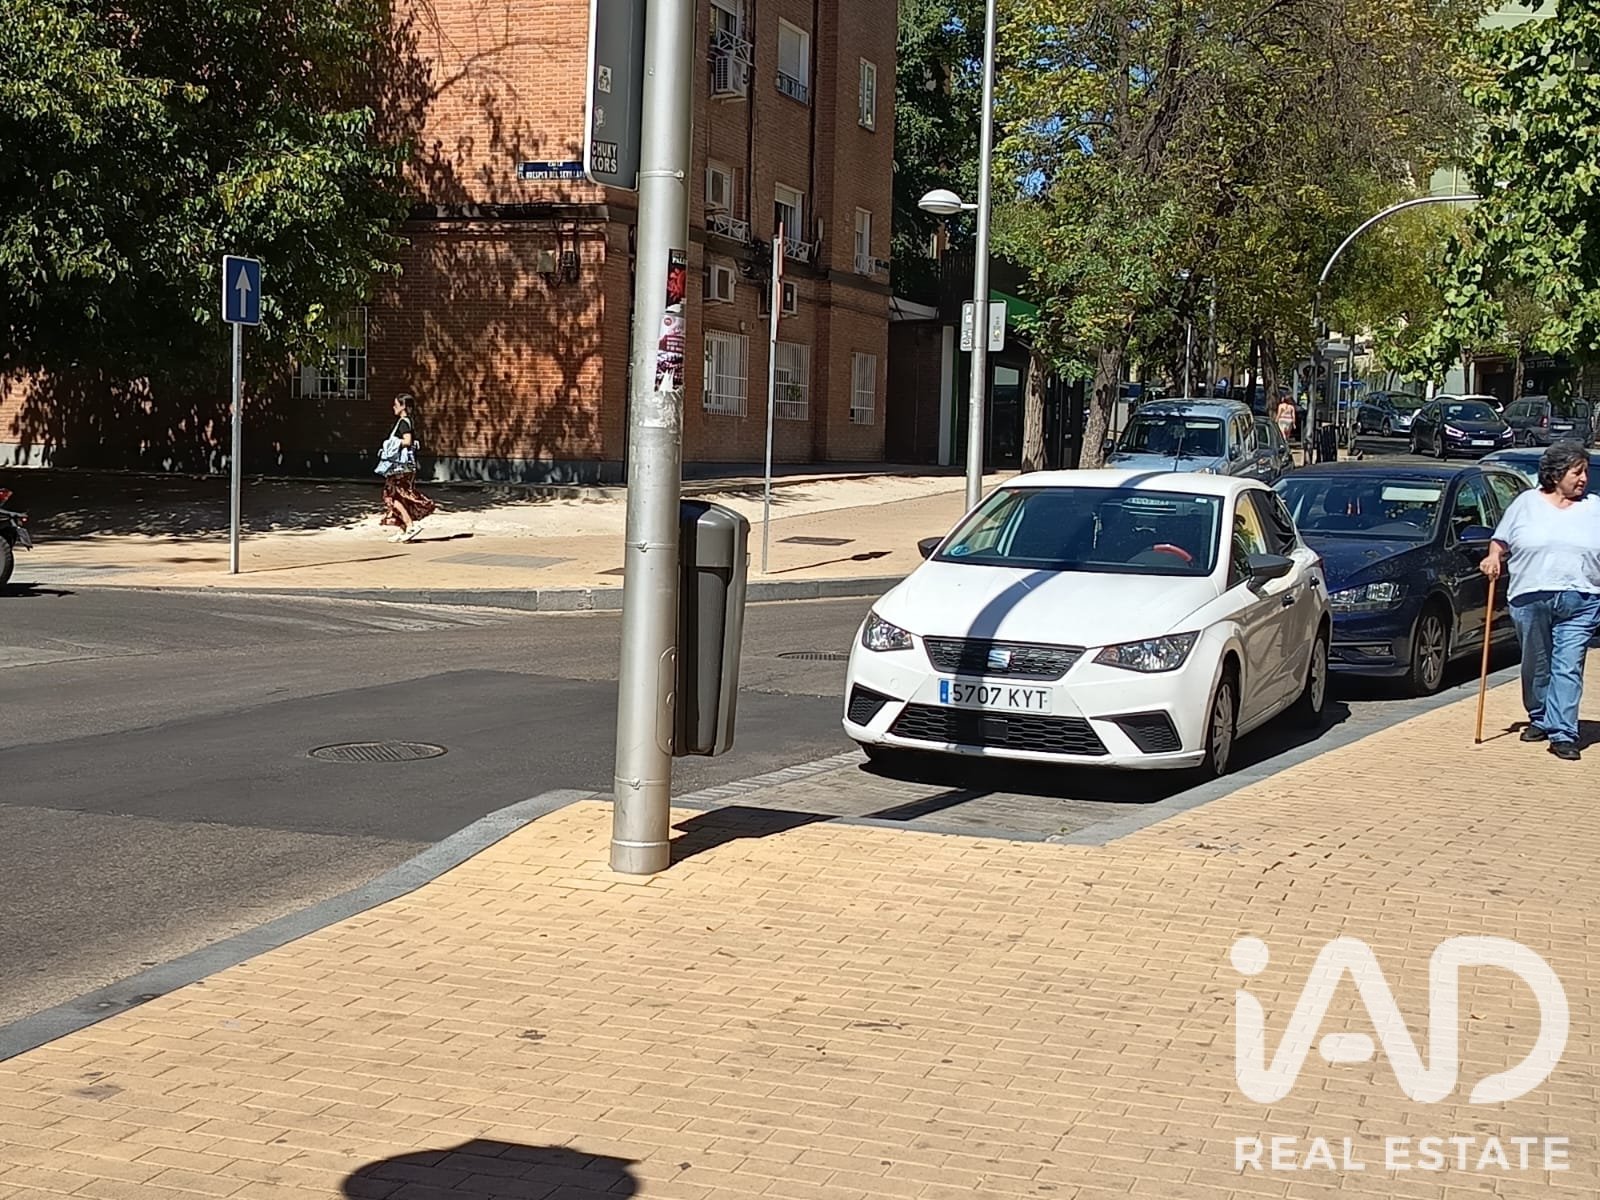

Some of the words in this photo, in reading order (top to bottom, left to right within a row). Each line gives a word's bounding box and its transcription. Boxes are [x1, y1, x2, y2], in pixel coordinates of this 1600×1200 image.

[592, 141, 617, 158] CHUKY
[591, 156, 617, 173] KORS
[953, 684, 1002, 705] 5707
[1008, 688, 1047, 709] KYT
